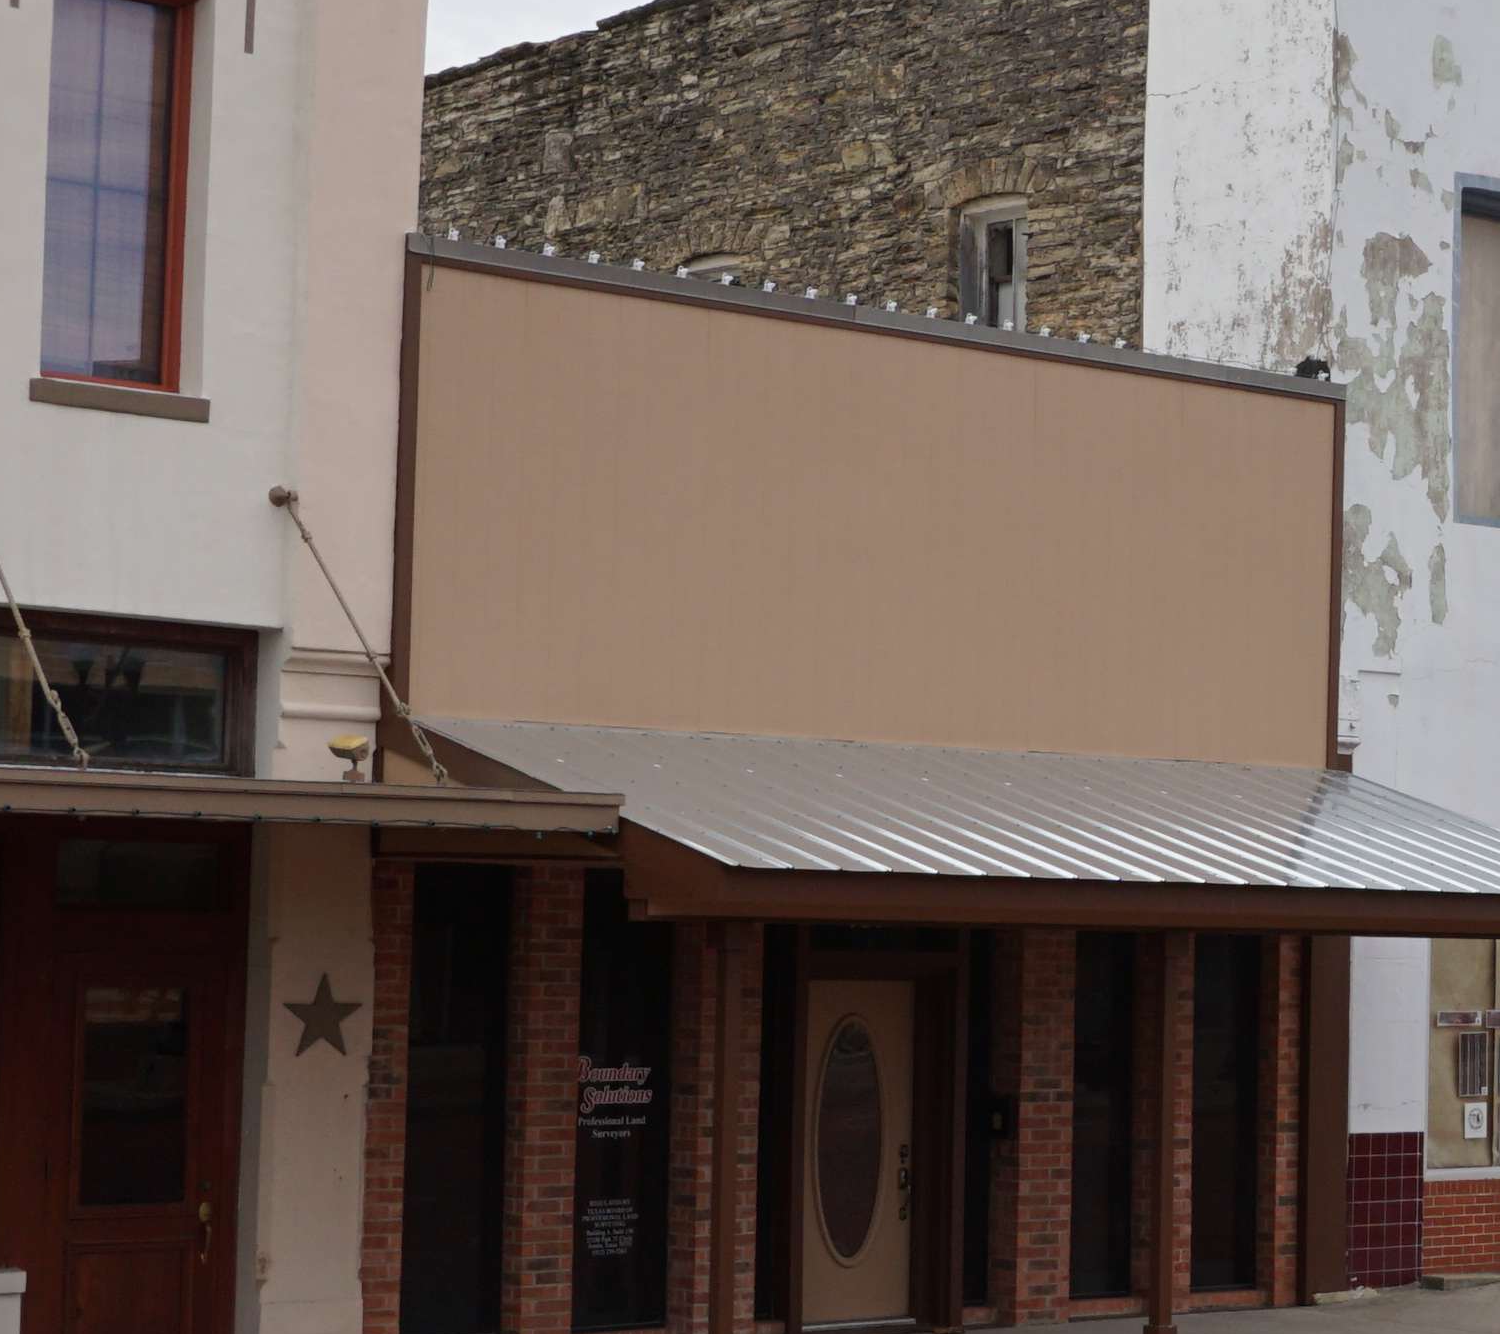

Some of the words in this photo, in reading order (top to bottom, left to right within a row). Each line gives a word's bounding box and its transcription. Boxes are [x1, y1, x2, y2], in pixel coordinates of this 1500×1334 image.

[578, 1055, 651, 1085] Boundary
[580, 1085, 653, 1114] Solutions
[625, 1115, 646, 1125] Land
[591, 1128, 631, 1140] Surveyors
